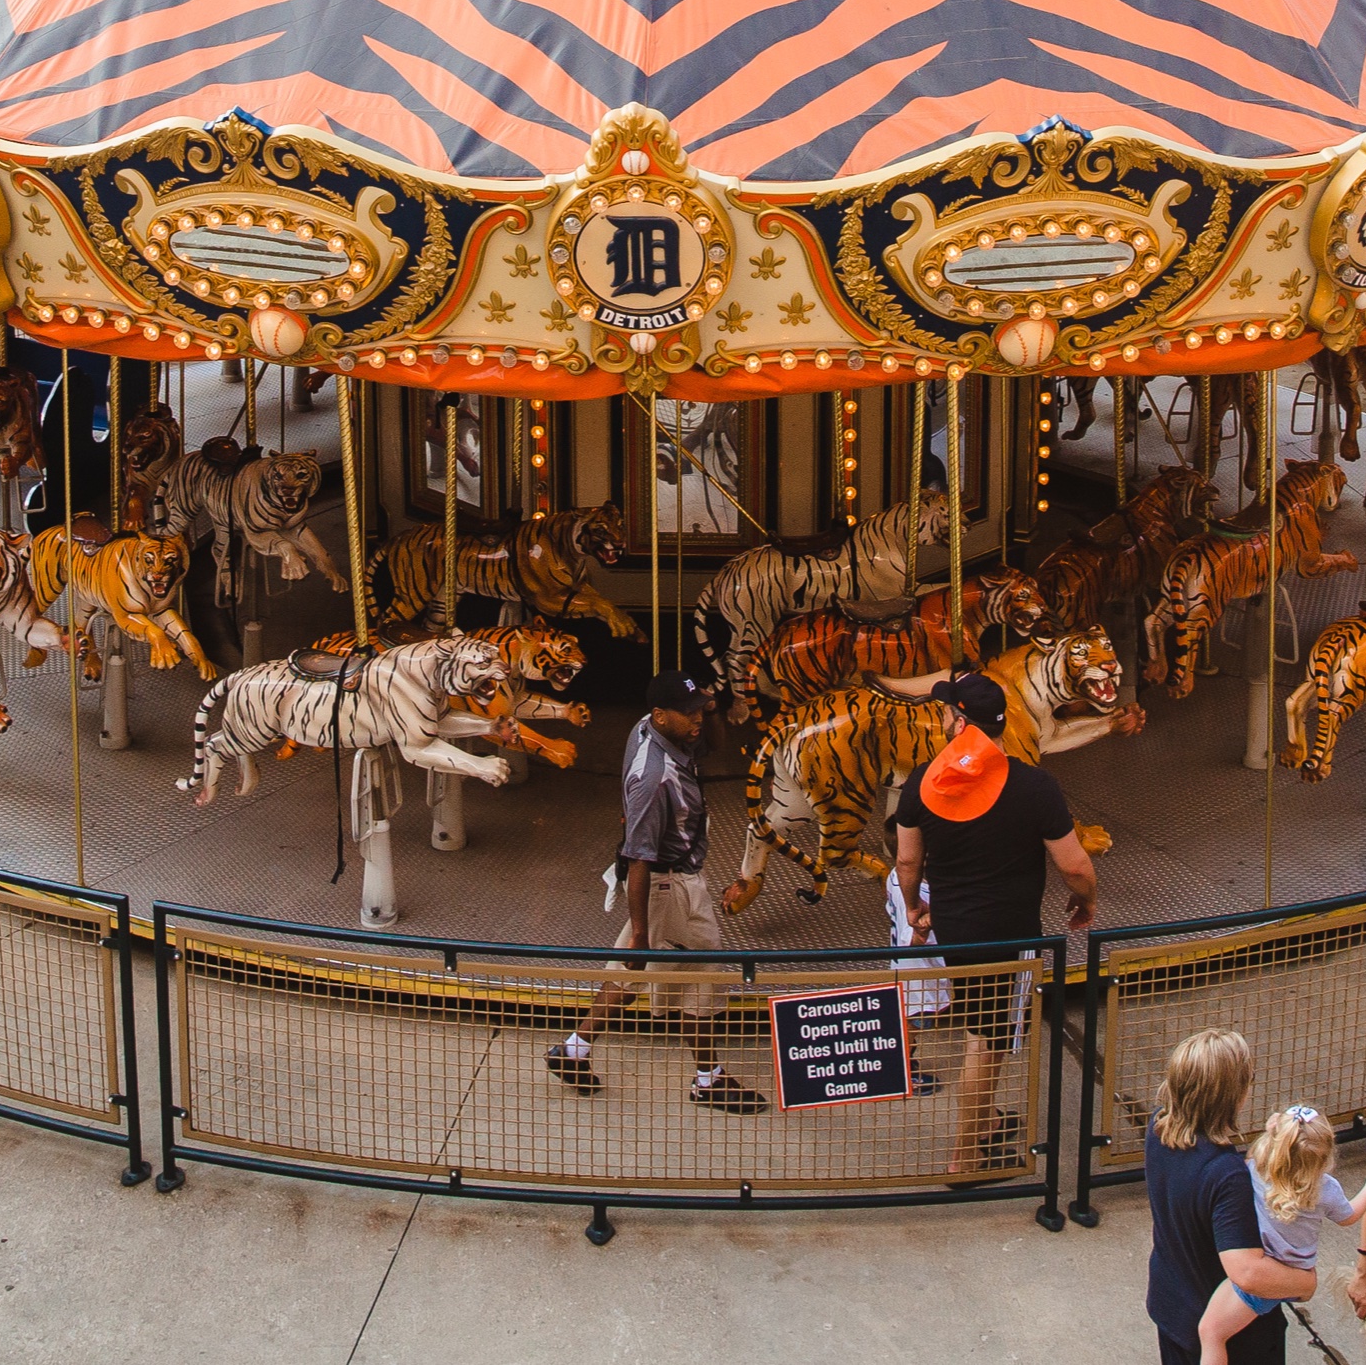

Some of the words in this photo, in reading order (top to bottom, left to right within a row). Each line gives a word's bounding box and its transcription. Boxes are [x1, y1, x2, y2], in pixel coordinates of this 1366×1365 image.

[606, 214, 682, 298] D
[599, 307, 686, 329] DETROIT
[797, 998, 863, 1019] Carousel
[867, 996, 881, 1010] is
[800, 1024, 839, 1040] Open
[842, 1018, 881, 1034] From
[788, 1045, 831, 1061] Gates
[834, 1038, 869, 1055] Until
[872, 1036, 897, 1051] the
[807, 1062, 835, 1079] End
[839, 1060, 854, 1075] of
[857, 1058, 882, 1073] the
[825, 1081, 868, 1097] Game
